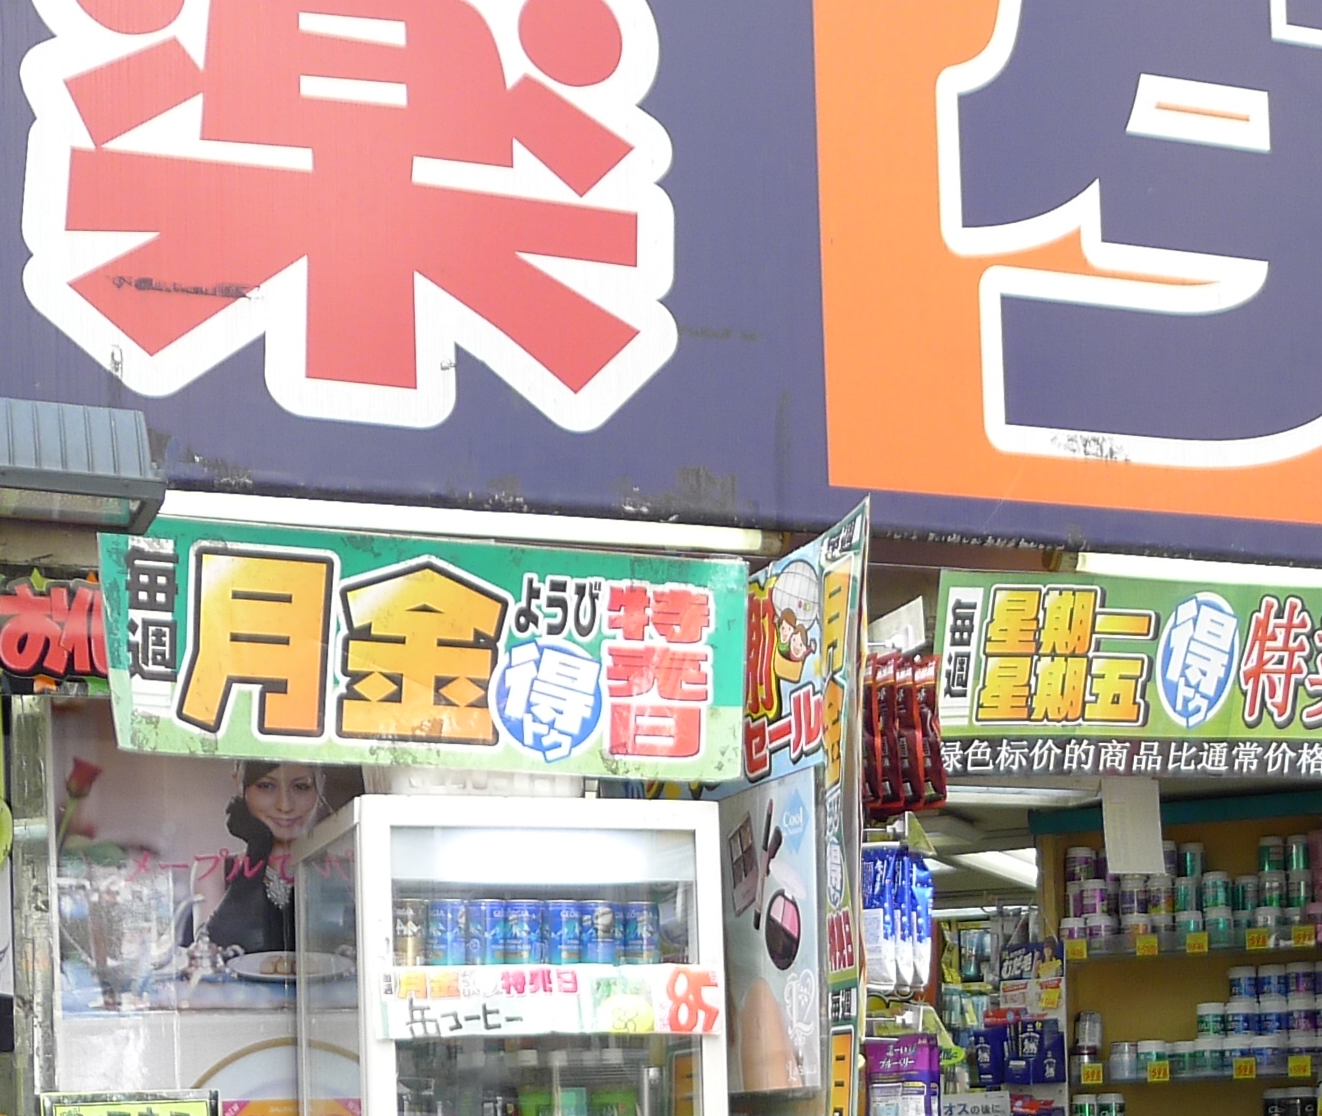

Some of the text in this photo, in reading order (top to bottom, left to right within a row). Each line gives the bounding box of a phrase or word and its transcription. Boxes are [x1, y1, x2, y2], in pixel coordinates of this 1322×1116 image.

[514, 574, 603, 637] ようび
[986, 587, 1156, 656] 星期一
[179, 541, 505, 748] 月金
[607, 583, 710, 758] 特売日
[977, 653, 1147, 724] 星期五
